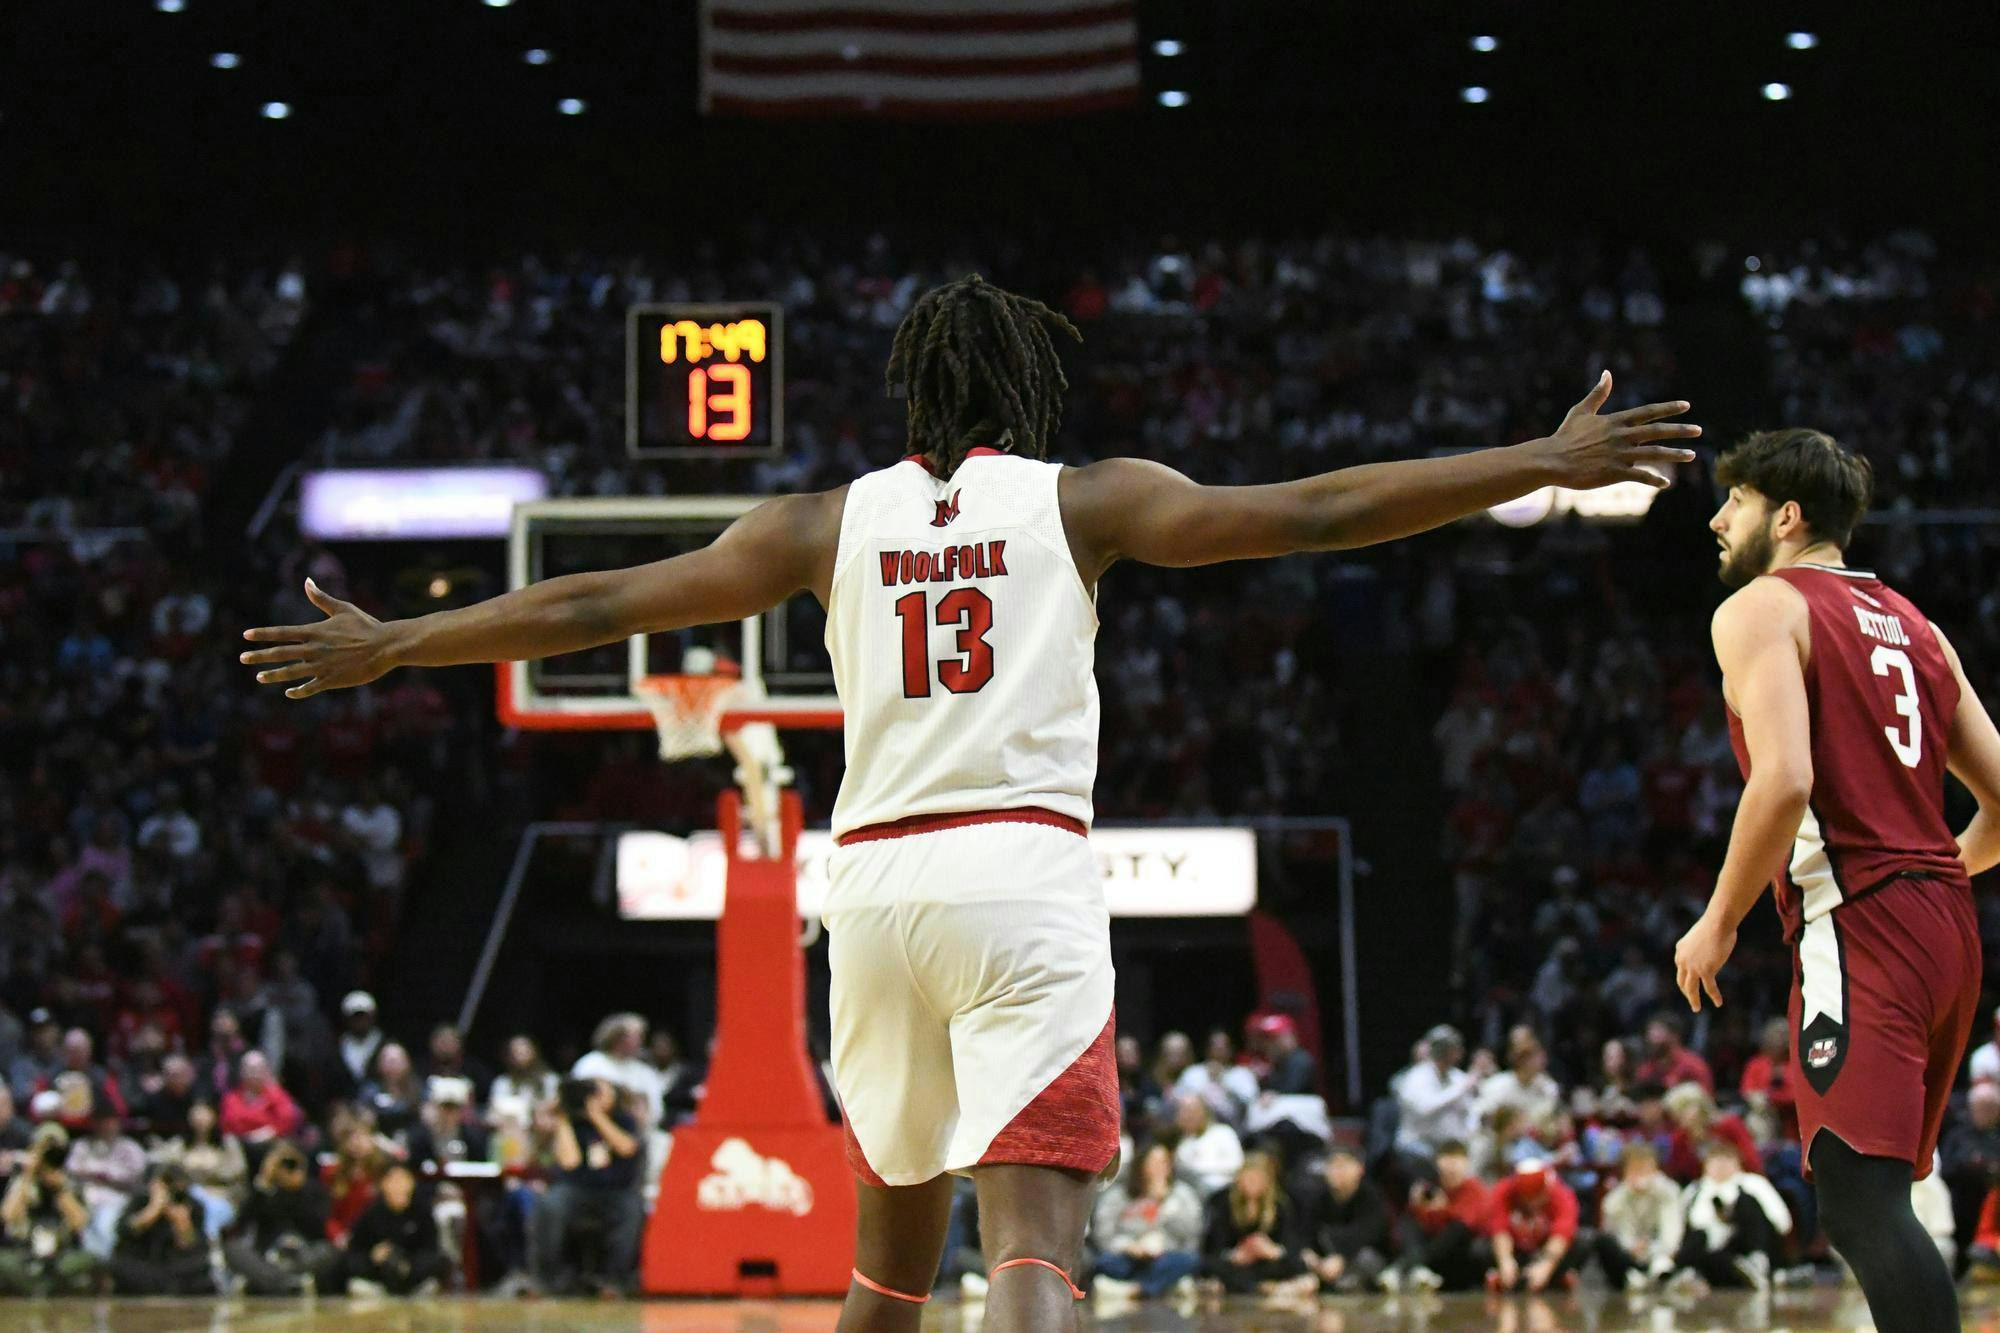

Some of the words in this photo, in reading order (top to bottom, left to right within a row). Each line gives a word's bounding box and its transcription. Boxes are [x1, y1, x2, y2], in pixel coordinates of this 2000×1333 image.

[660, 319, 766, 364] 17:49
[688, 364, 752, 440] 13
[929, 488, 962, 527] M
[879, 540, 1009, 587] WOOLFOLK
[895, 587, 994, 698] 13
[1870, 645, 1922, 768] 3
